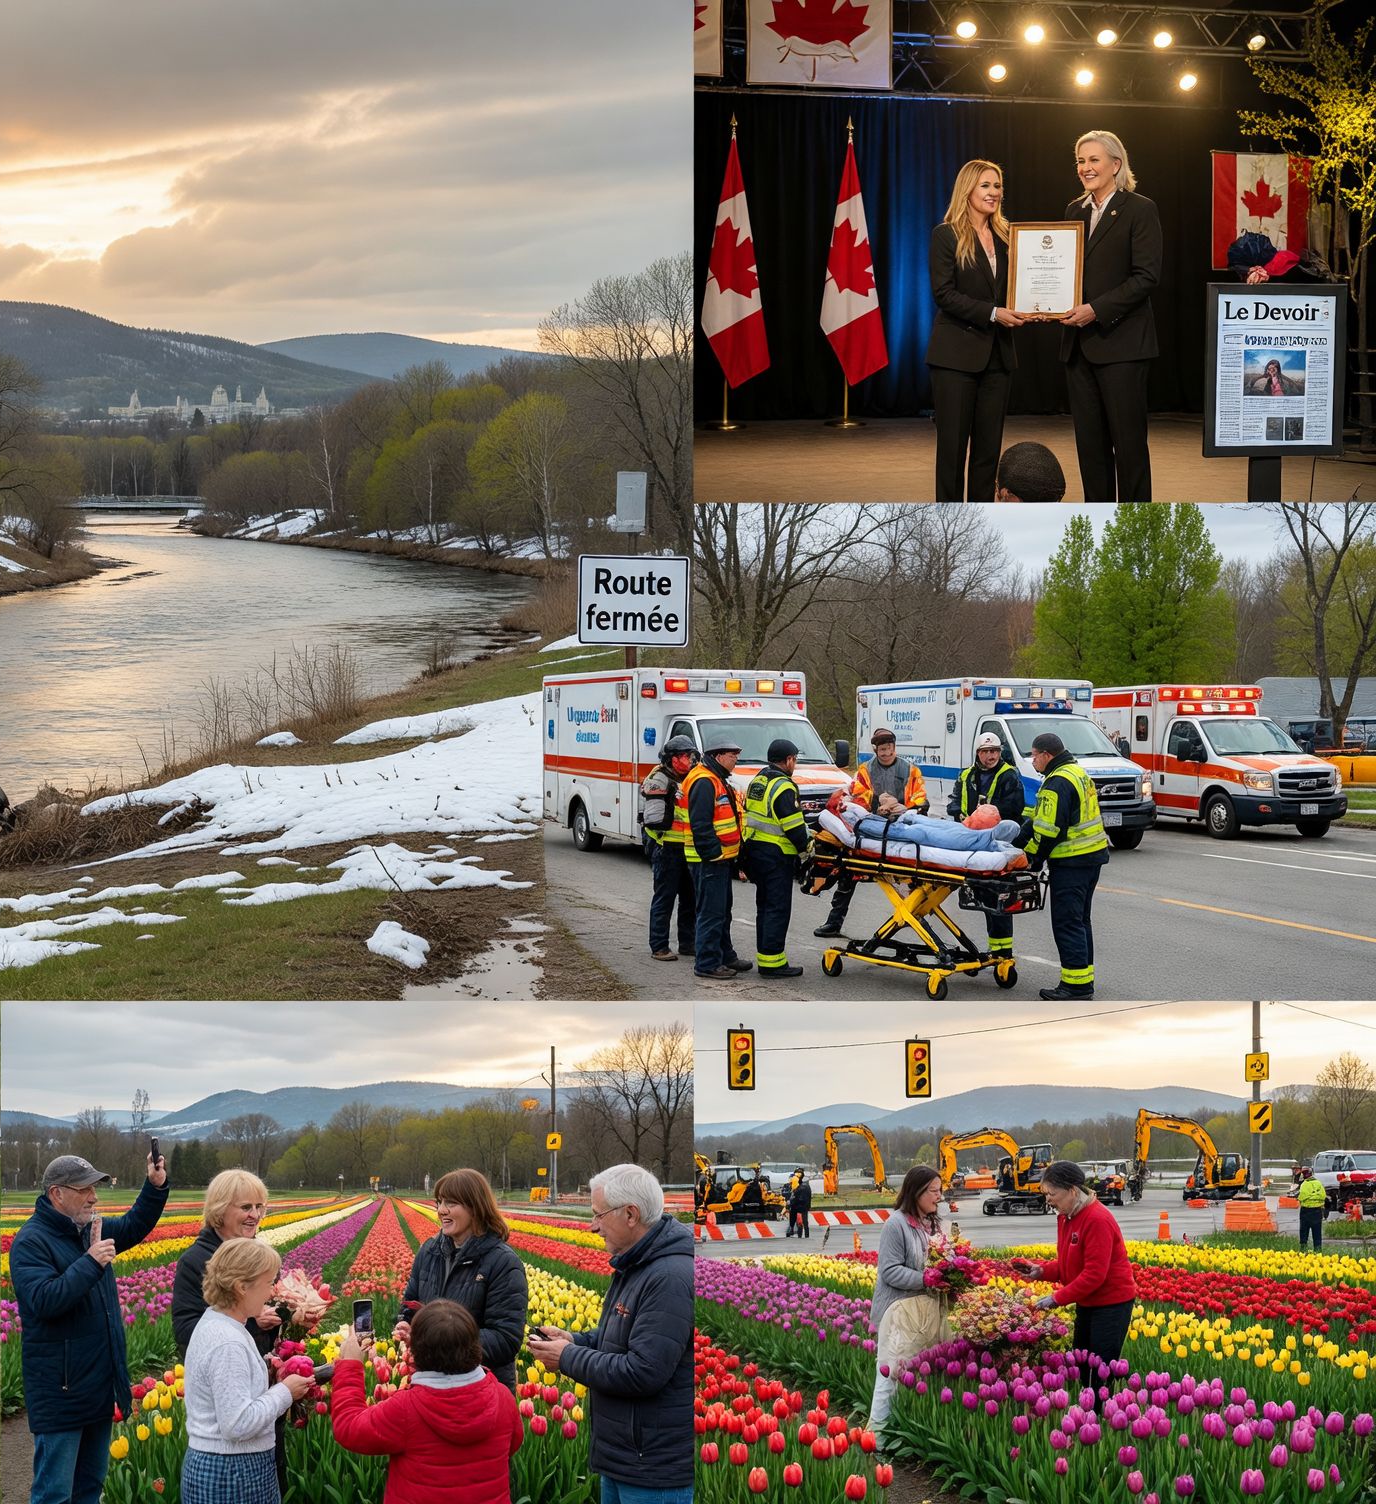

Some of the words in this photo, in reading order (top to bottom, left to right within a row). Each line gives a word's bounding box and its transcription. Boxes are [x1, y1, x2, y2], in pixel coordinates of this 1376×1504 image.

[1224, 301, 1248, 320] Le
[1254, 302, 1320, 321] Devoir
[594, 568, 671, 596] Route
[586, 603, 679, 632] fermée
